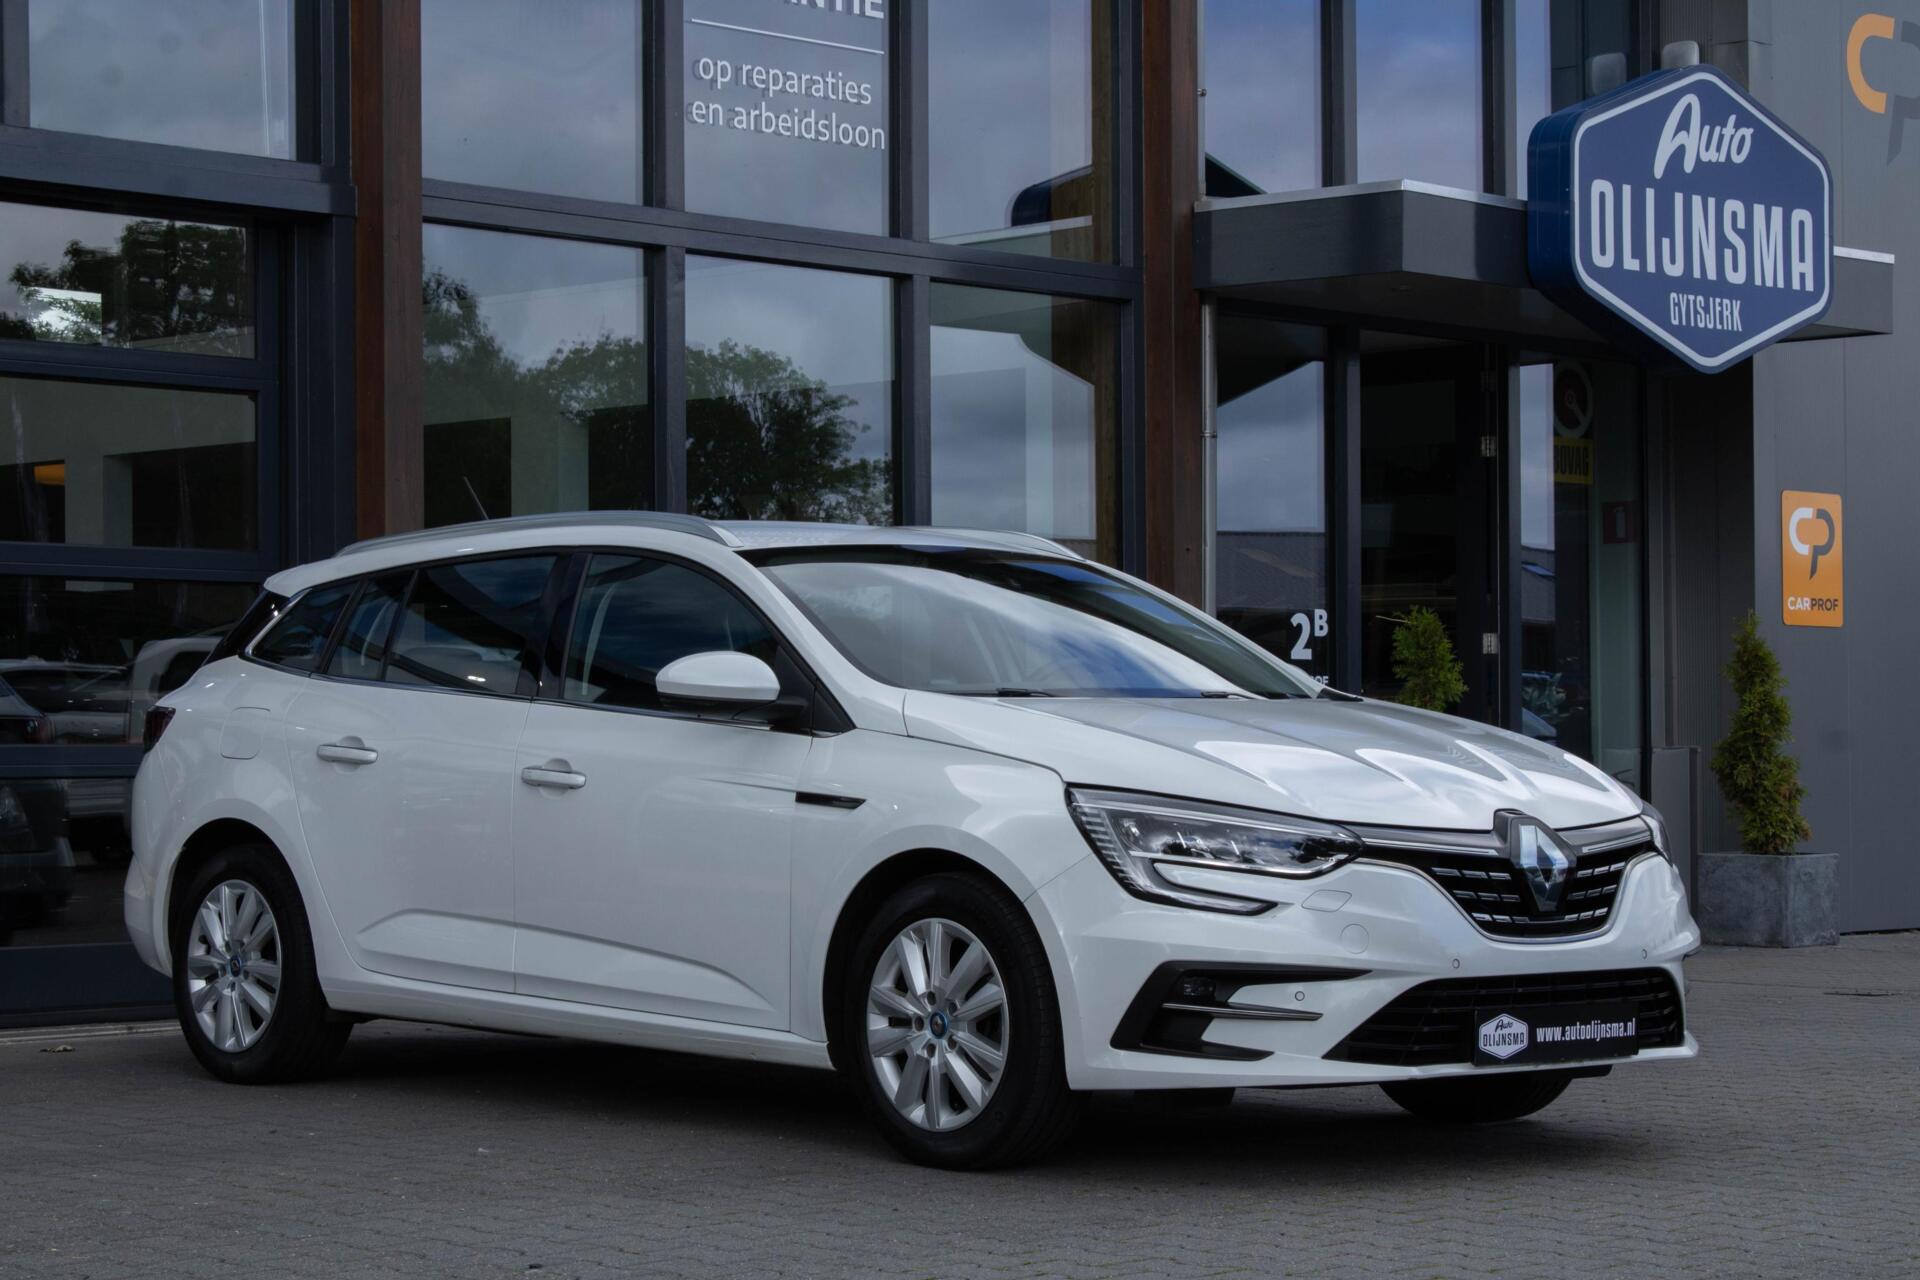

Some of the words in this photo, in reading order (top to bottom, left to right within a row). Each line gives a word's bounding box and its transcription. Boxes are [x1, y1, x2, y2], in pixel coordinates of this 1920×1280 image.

[699, 57, 731, 89] op
[742, 63, 872, 105] reparaties
[692, 100, 723, 125] en
[733, 101, 885, 149] arbeidsloon
[1653, 93, 1754, 179] Auto
[1590, 178, 1814, 292] OLIJNSMA
[1670, 292, 1742, 331] GYTSJERK
[1787, 596, 1839, 611] CARPROF
[1482, 1031, 1525, 1047] OLIJNSMA
[1494, 1018, 1513, 1032] Auto
[1536, 1017, 1636, 1043] www.autoolijnsma.nl
